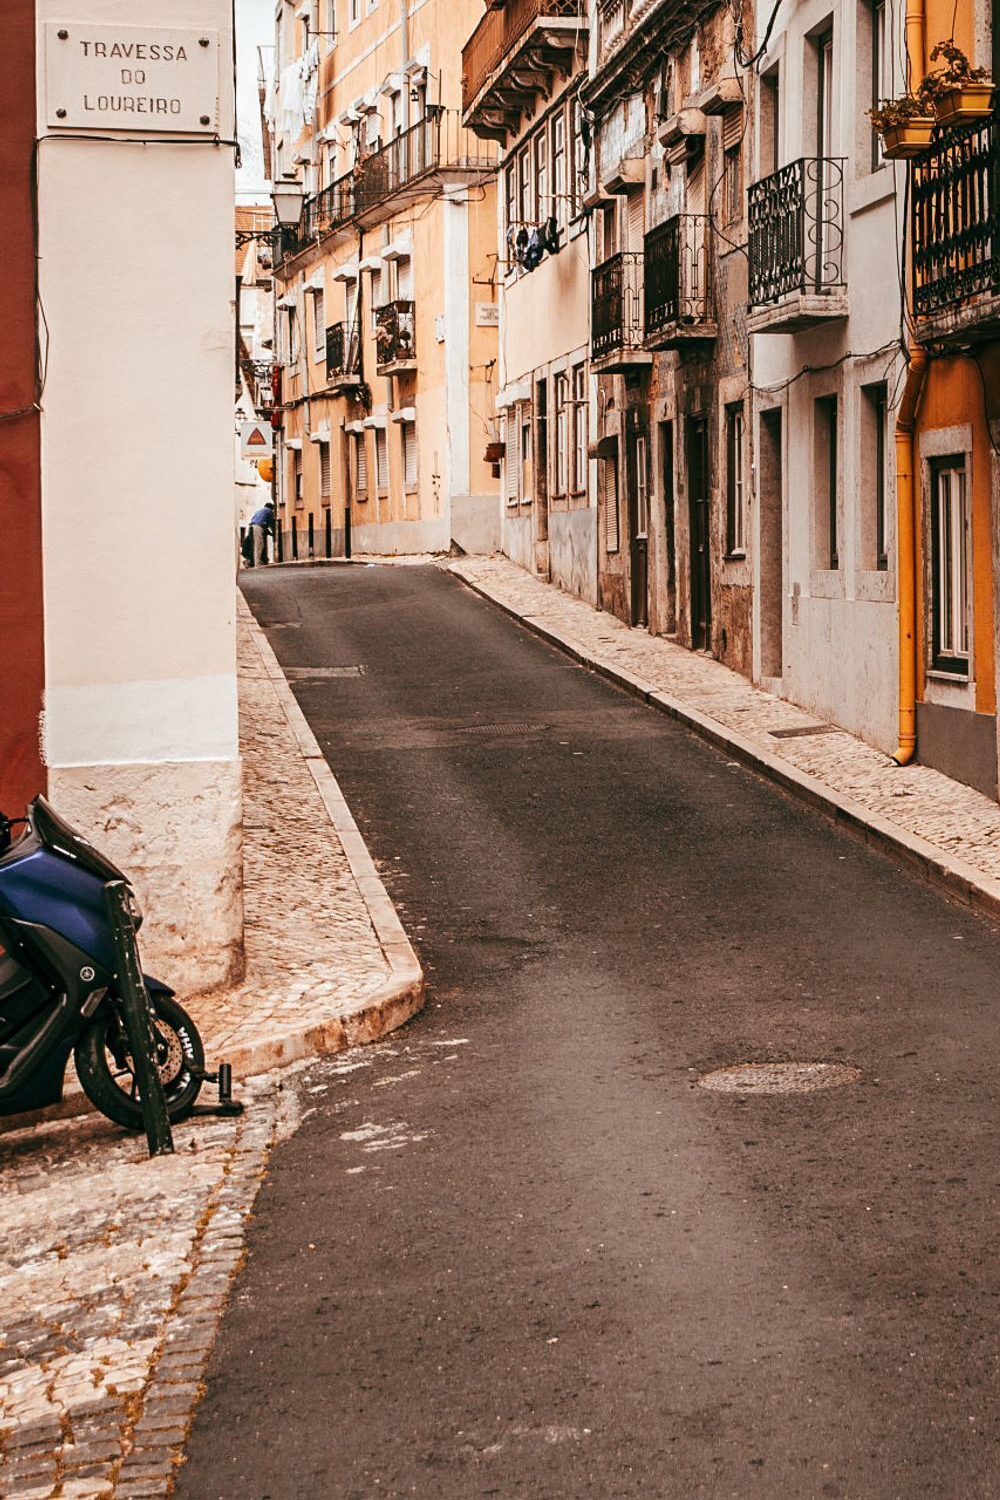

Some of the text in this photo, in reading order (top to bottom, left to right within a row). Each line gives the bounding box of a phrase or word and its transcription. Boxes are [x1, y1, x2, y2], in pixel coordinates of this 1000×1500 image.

[79, 41, 188, 61] TRAVESSA
[121, 69, 146, 85] DO
[84, 95, 181, 114] LOUREIRO
